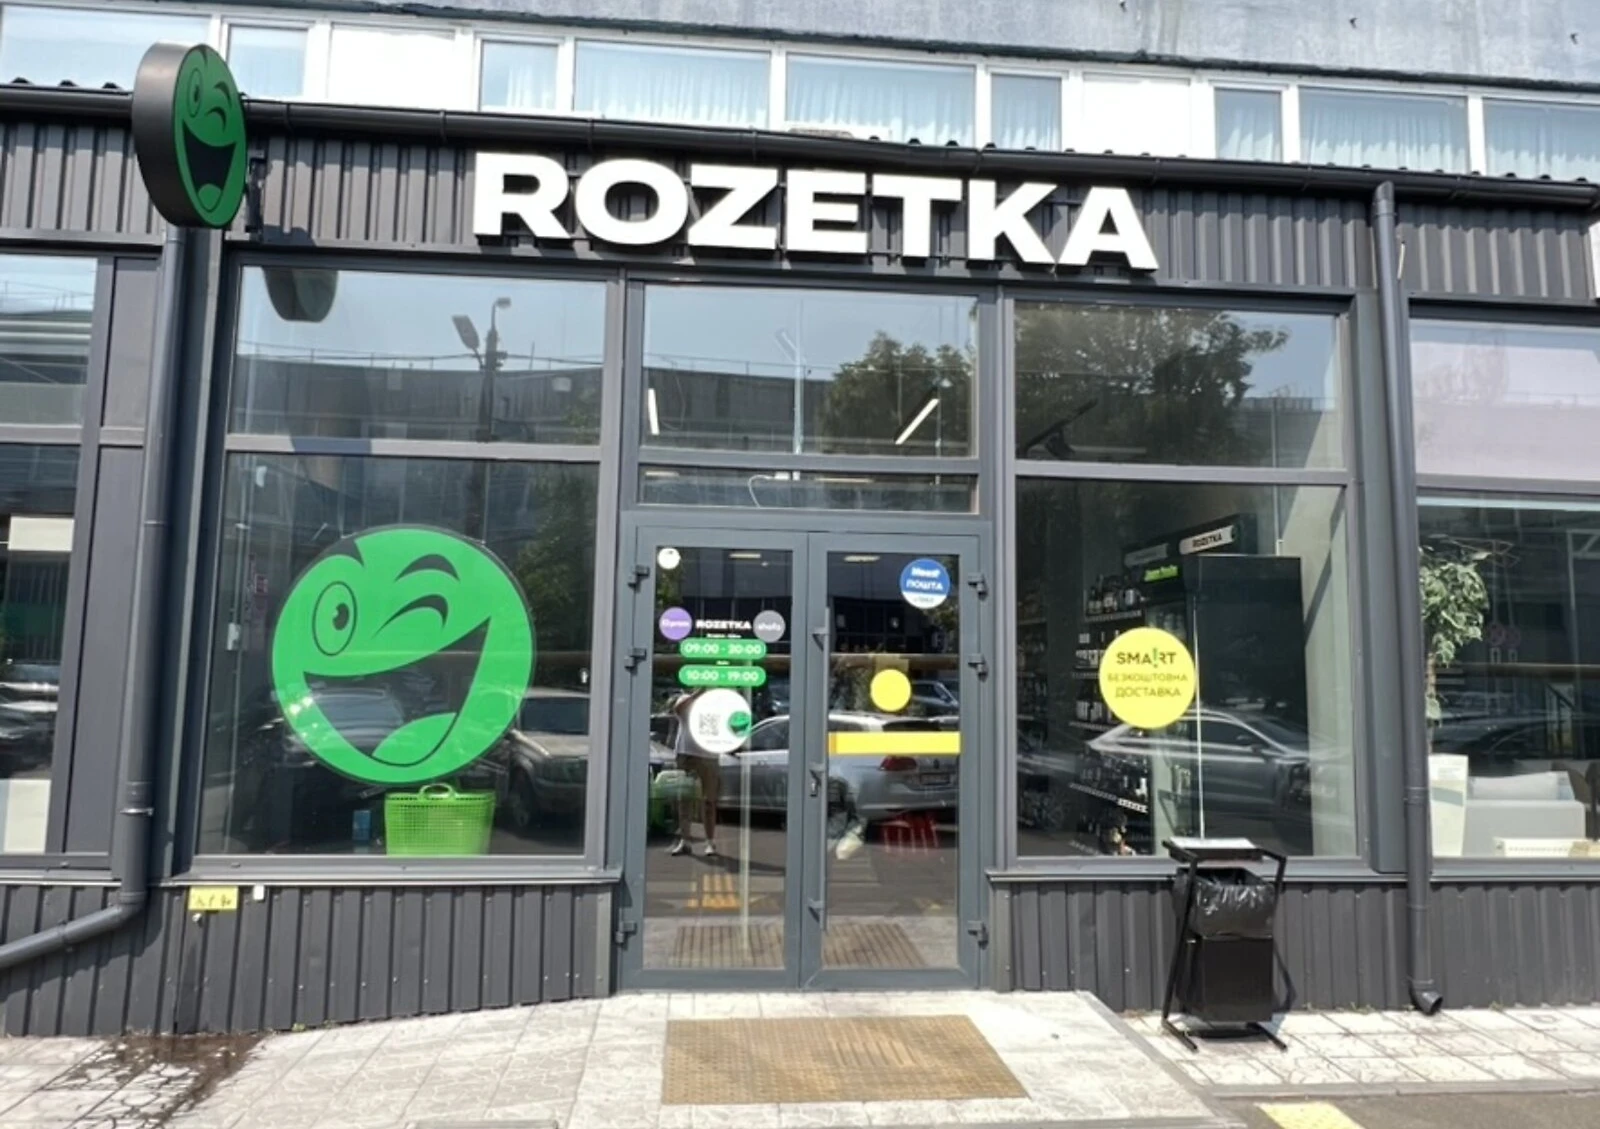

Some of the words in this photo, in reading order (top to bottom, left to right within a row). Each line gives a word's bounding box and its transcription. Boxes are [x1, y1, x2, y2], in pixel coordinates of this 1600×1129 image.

[473, 151, 1159, 271] ROZETKA
[695, 619, 752, 630] ROZETKA
[686, 670, 719, 681] 10:00
[1107, 672, 1188, 683] БЕЗКОШТОВНА
[1115, 686, 1182, 698] ДОСТАВКА
